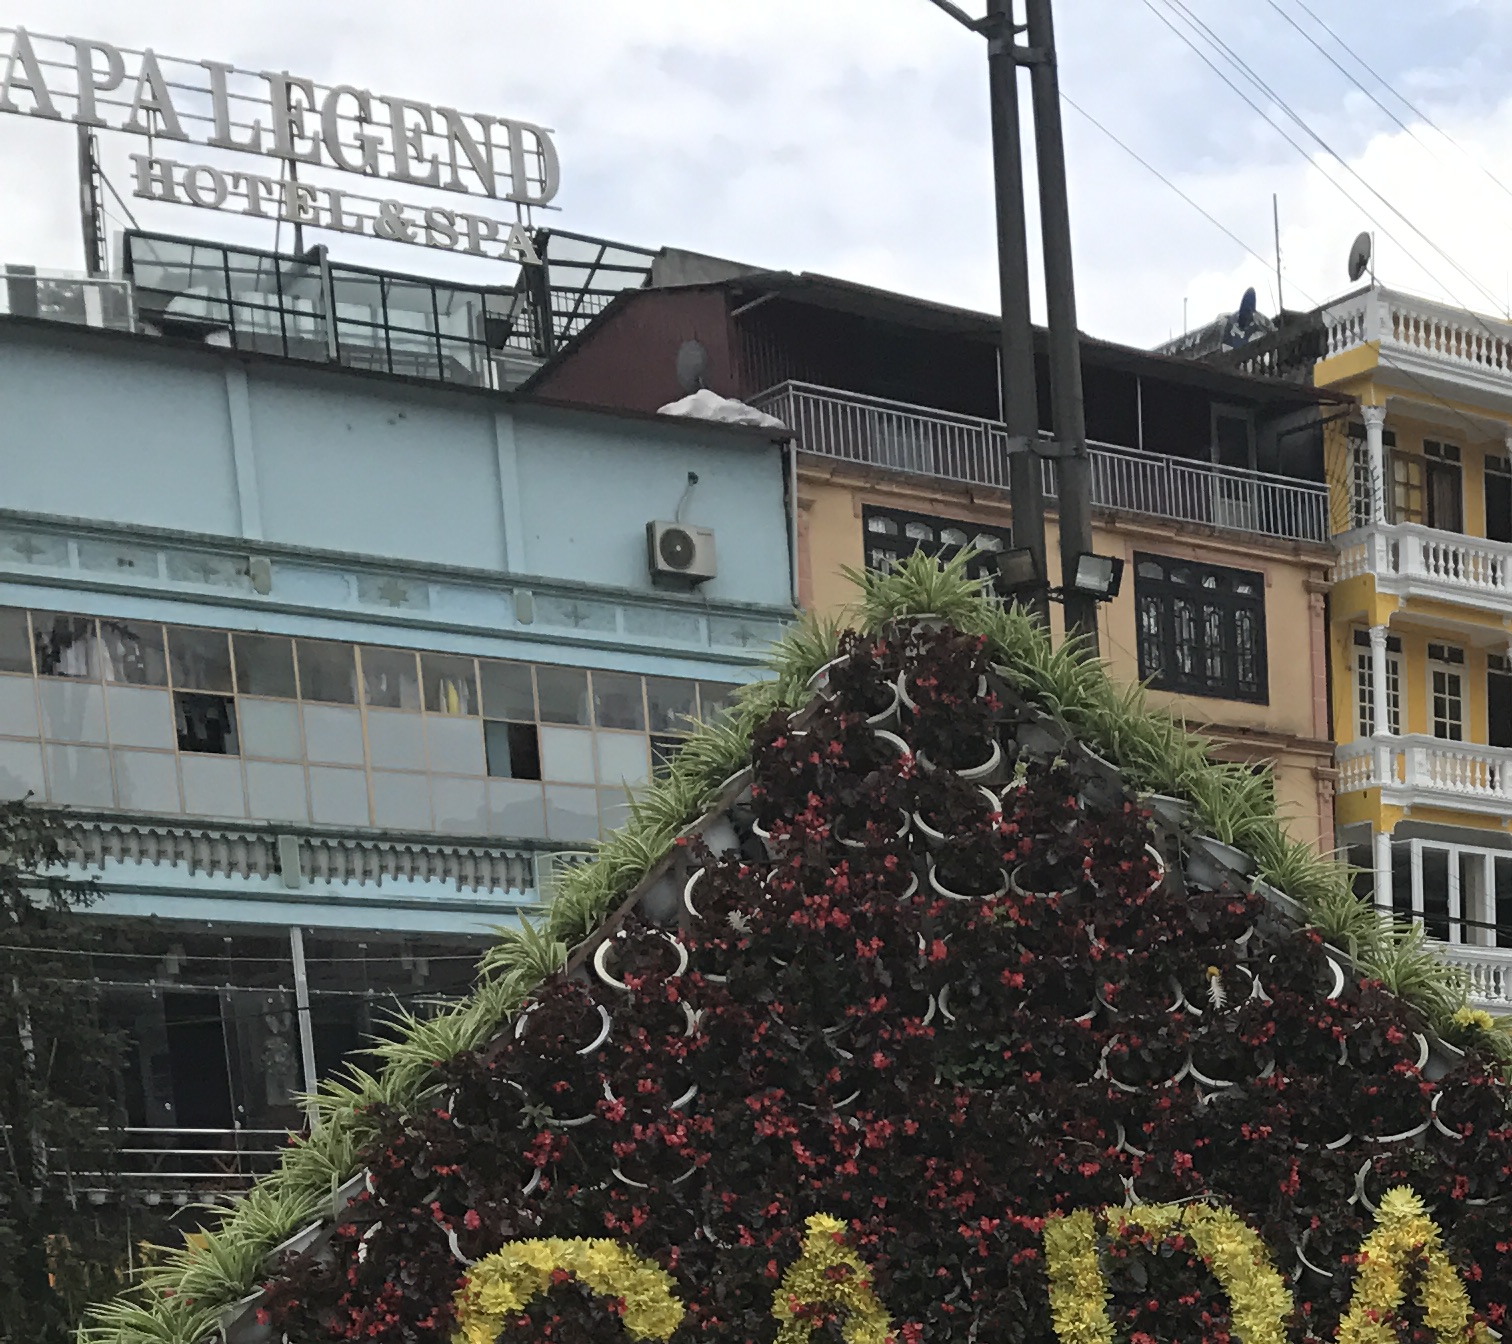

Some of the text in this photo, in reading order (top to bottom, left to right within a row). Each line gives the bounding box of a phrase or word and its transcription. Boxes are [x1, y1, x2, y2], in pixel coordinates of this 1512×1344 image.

[201, 59, 560, 207] LEGEND
[129, 153, 543, 265] HOTEL & SPA
